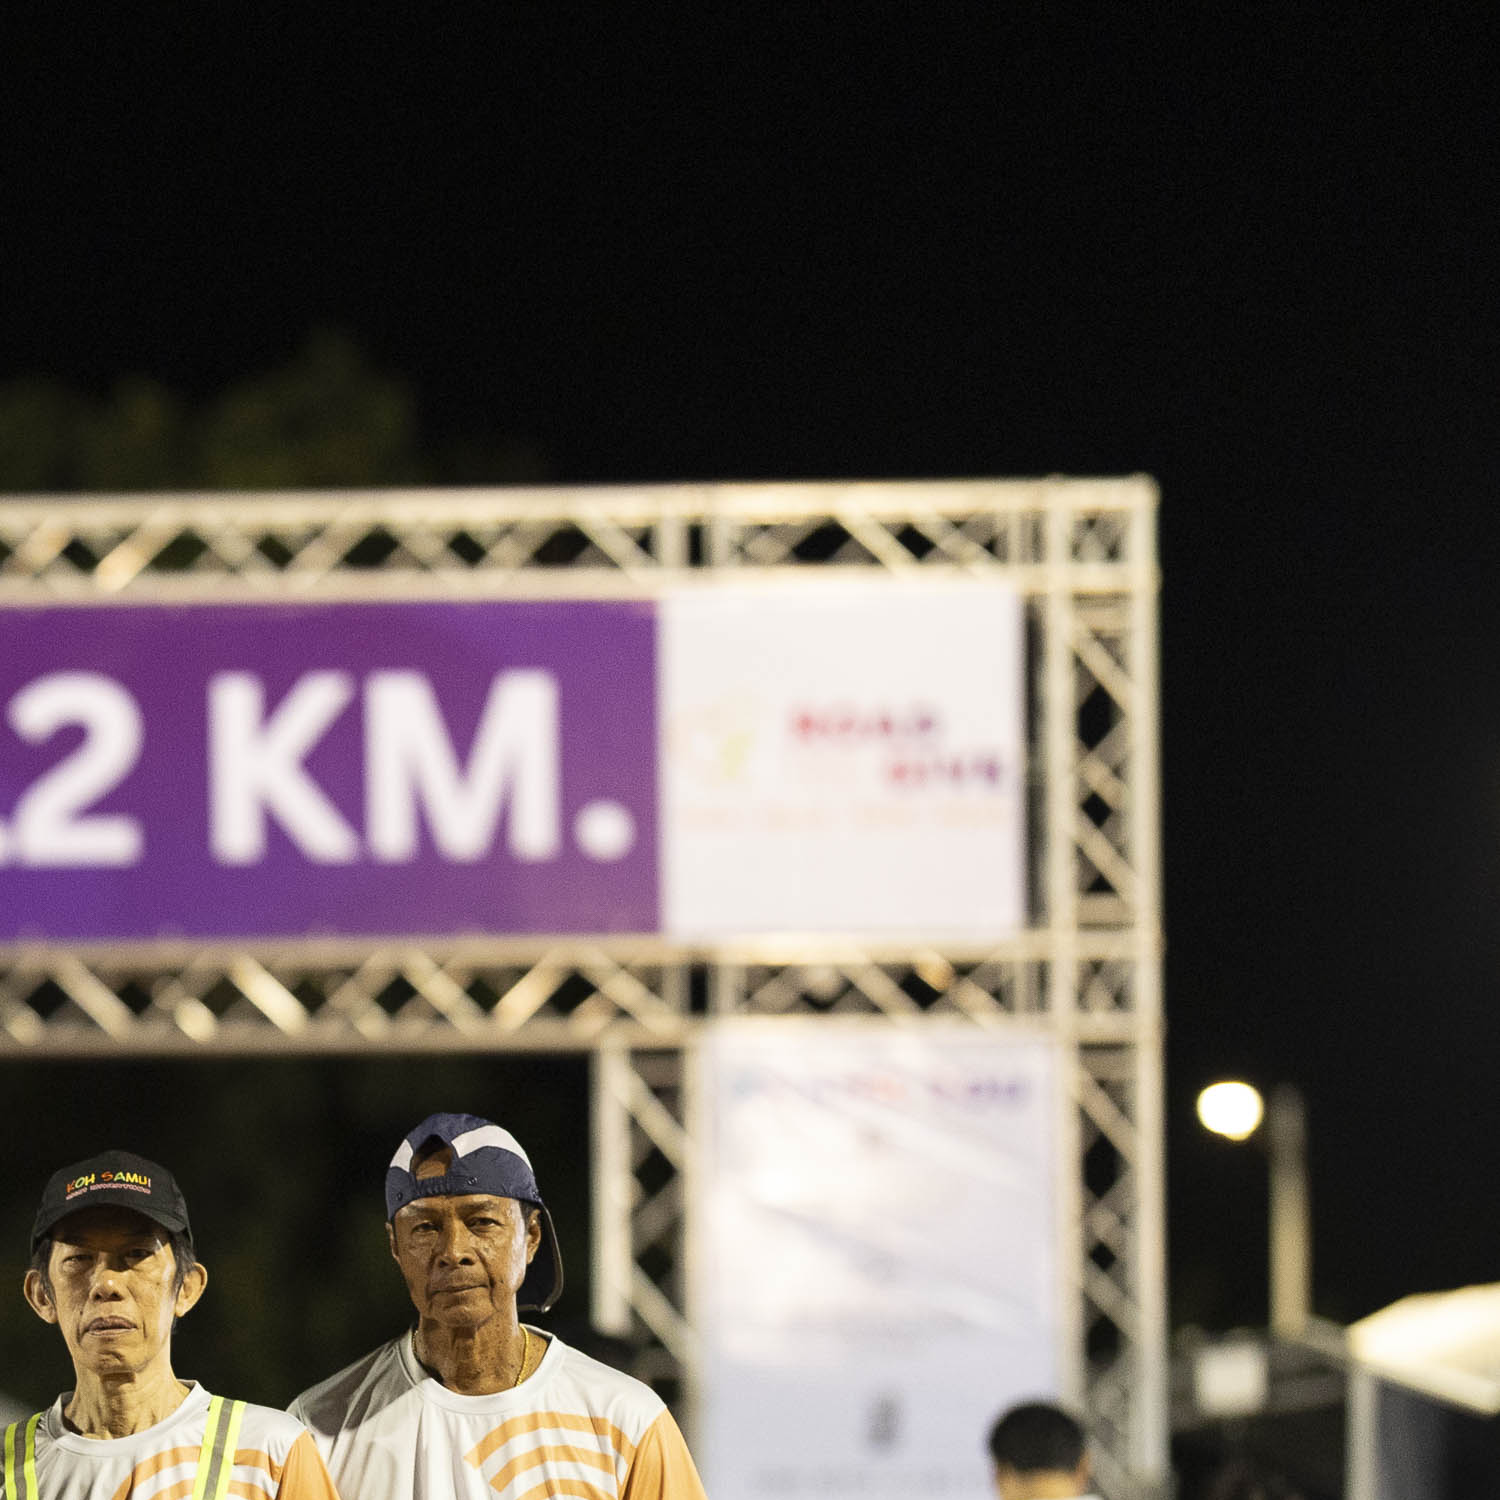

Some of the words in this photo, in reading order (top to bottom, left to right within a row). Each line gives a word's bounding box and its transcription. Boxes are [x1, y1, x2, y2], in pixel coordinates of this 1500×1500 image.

[207, 666, 635, 866] KM.
[66, 1173, 96, 1192] KOH
[101, 1171, 151, 1188] SAMUI
